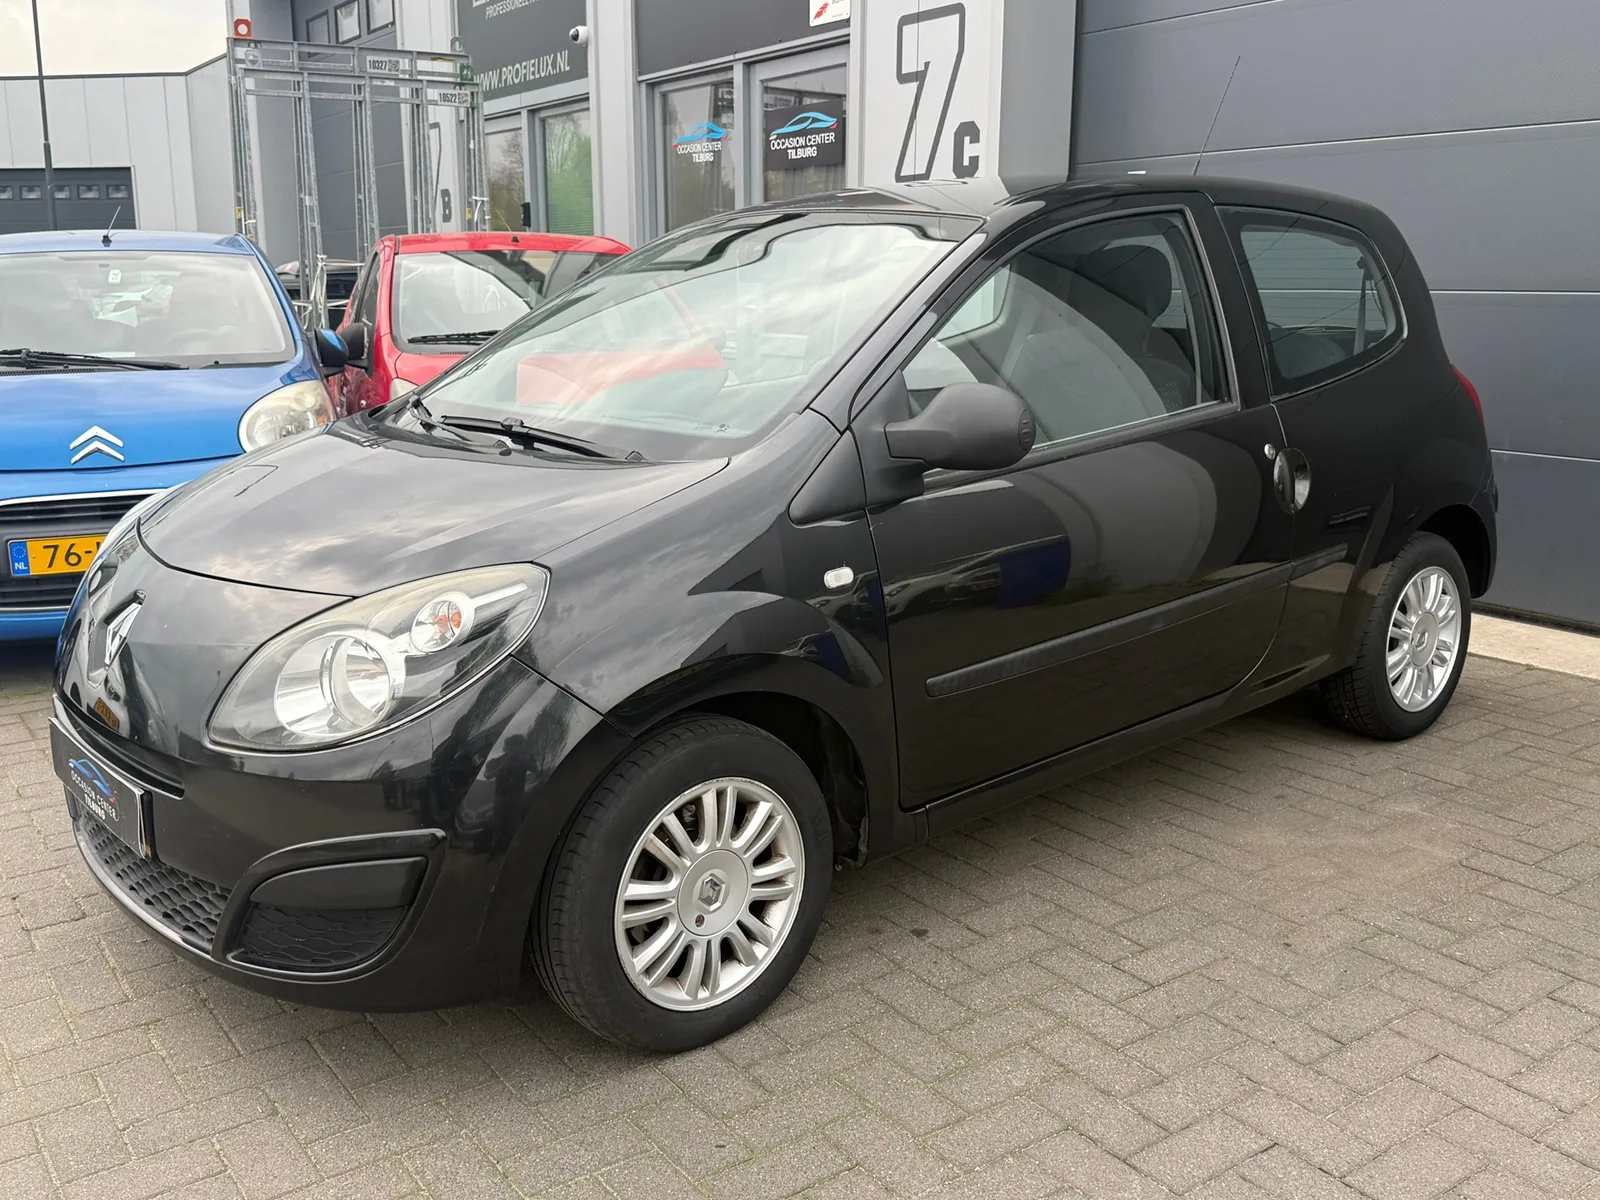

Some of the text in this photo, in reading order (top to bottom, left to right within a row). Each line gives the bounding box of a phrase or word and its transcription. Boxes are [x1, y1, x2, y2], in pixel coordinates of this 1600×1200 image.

[368, 59, 387, 70] 10327
[439, 92, 457, 103] 10522
[677, 141, 722, 154] OCCASION CENTER
[770, 132, 835, 150] OCCASION CENTER
[692, 152, 714, 162] TILBURG
[787, 147, 817, 160] TILBURG
[43, 542, 100, 568] 76-
[14, 562, 28, 570] NL
[71, 770, 116, 819] OCCASION CENTER
